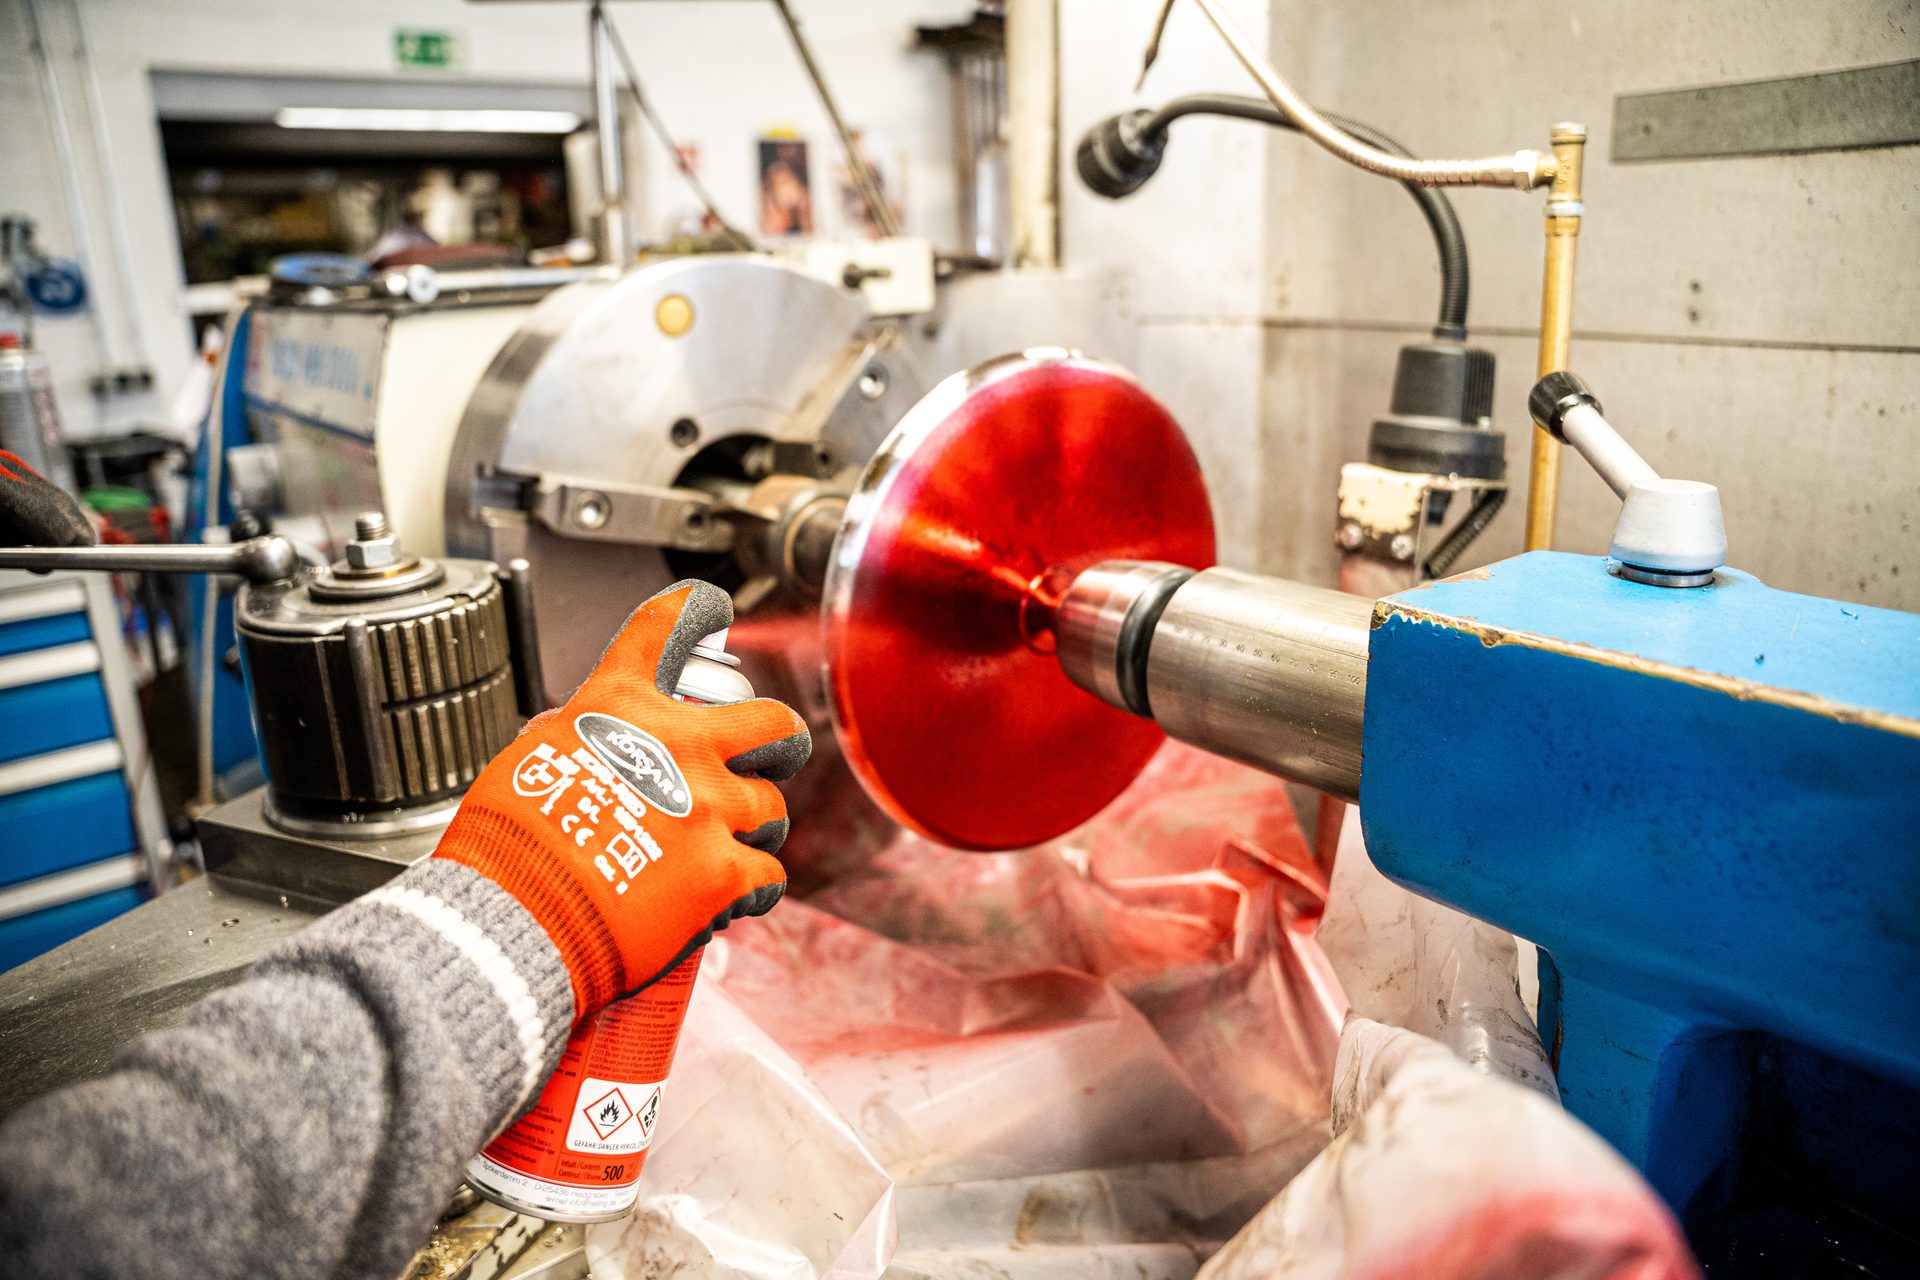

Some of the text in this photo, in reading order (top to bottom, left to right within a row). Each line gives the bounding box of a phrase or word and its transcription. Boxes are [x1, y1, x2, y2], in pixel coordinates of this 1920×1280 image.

[1236, 644, 1246, 653] 40
[1253, 648, 1264, 658] 50
[1271, 653, 1281, 663] 60
[1346, 674, 1361, 686] 100
[605, 730, 675, 796] KORSAR
[601, 1164, 625, 1181] 500
